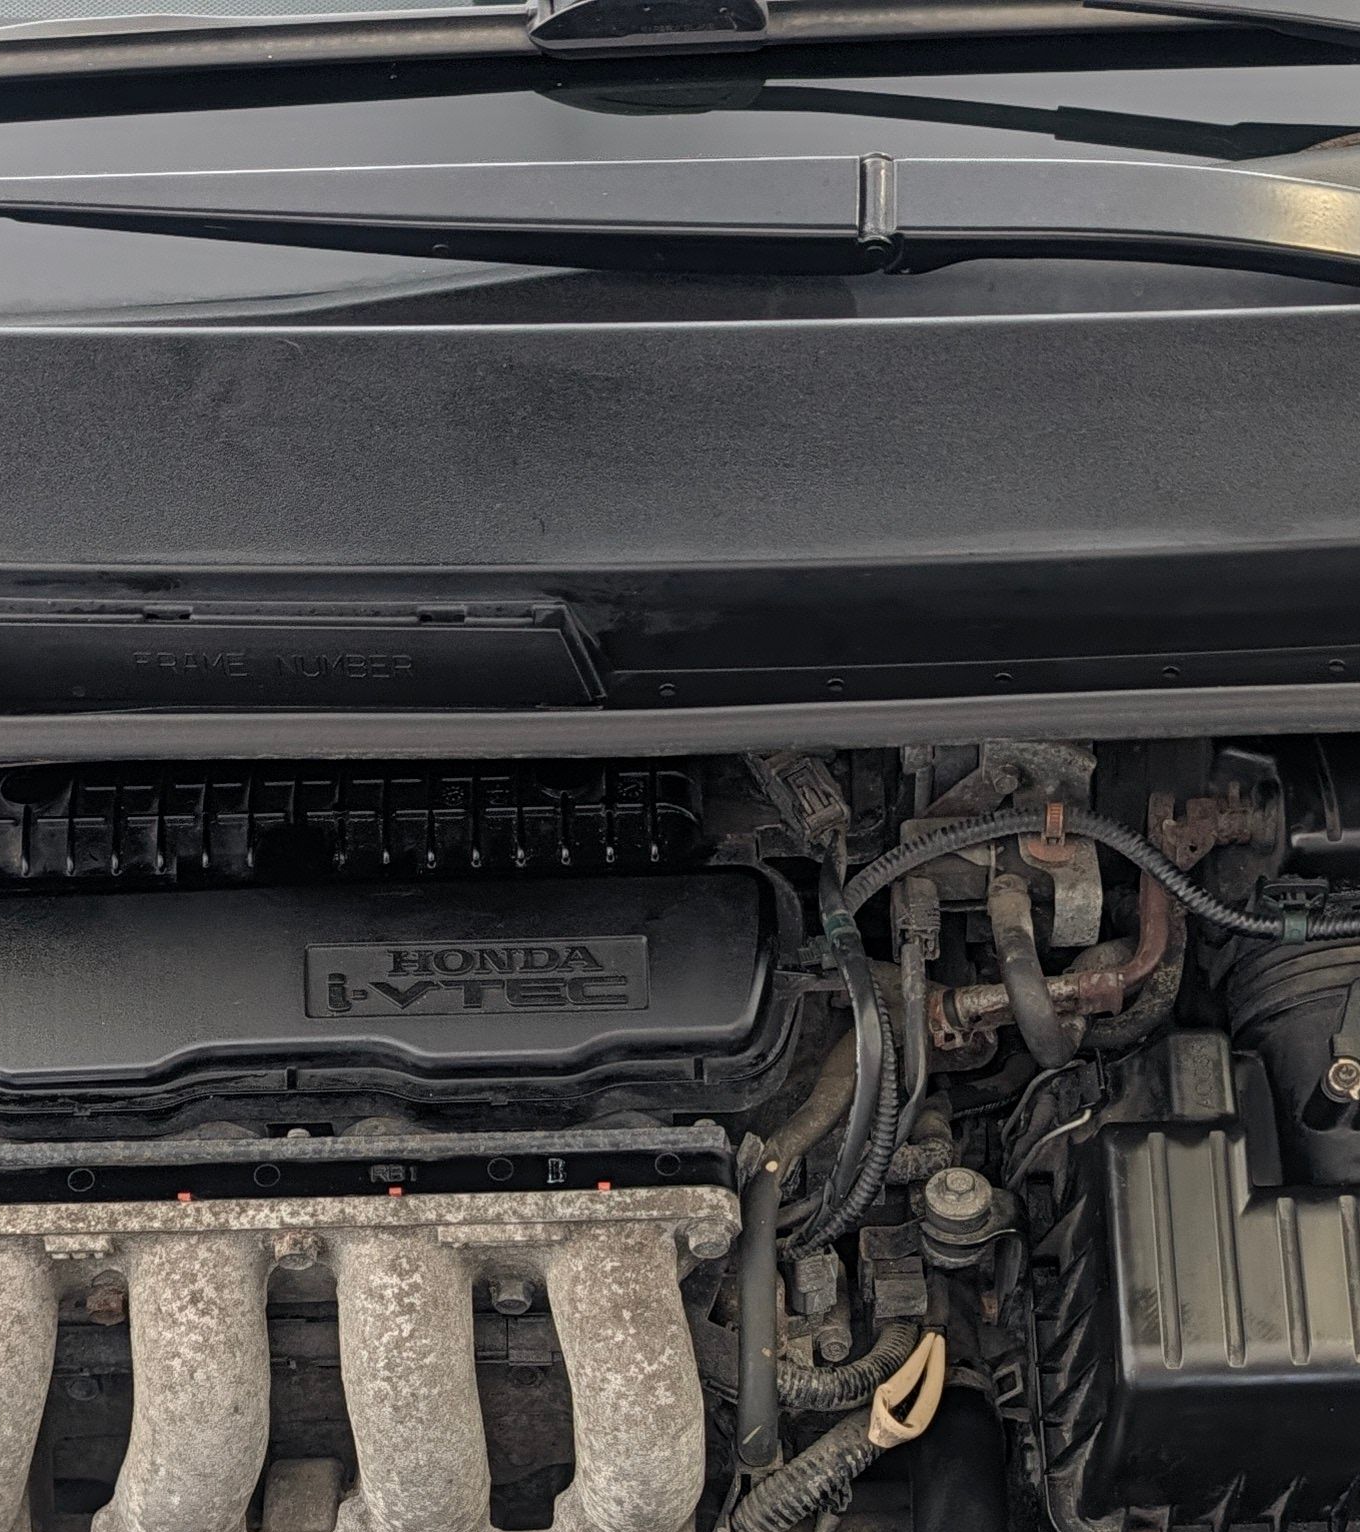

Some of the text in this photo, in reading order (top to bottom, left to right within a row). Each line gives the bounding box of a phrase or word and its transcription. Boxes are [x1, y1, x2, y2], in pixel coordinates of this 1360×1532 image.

[133, 652, 414, 679] FRAME NUMBER
[387, 946, 605, 976] HONDA
[327, 972, 628, 1011] i-VTEC
